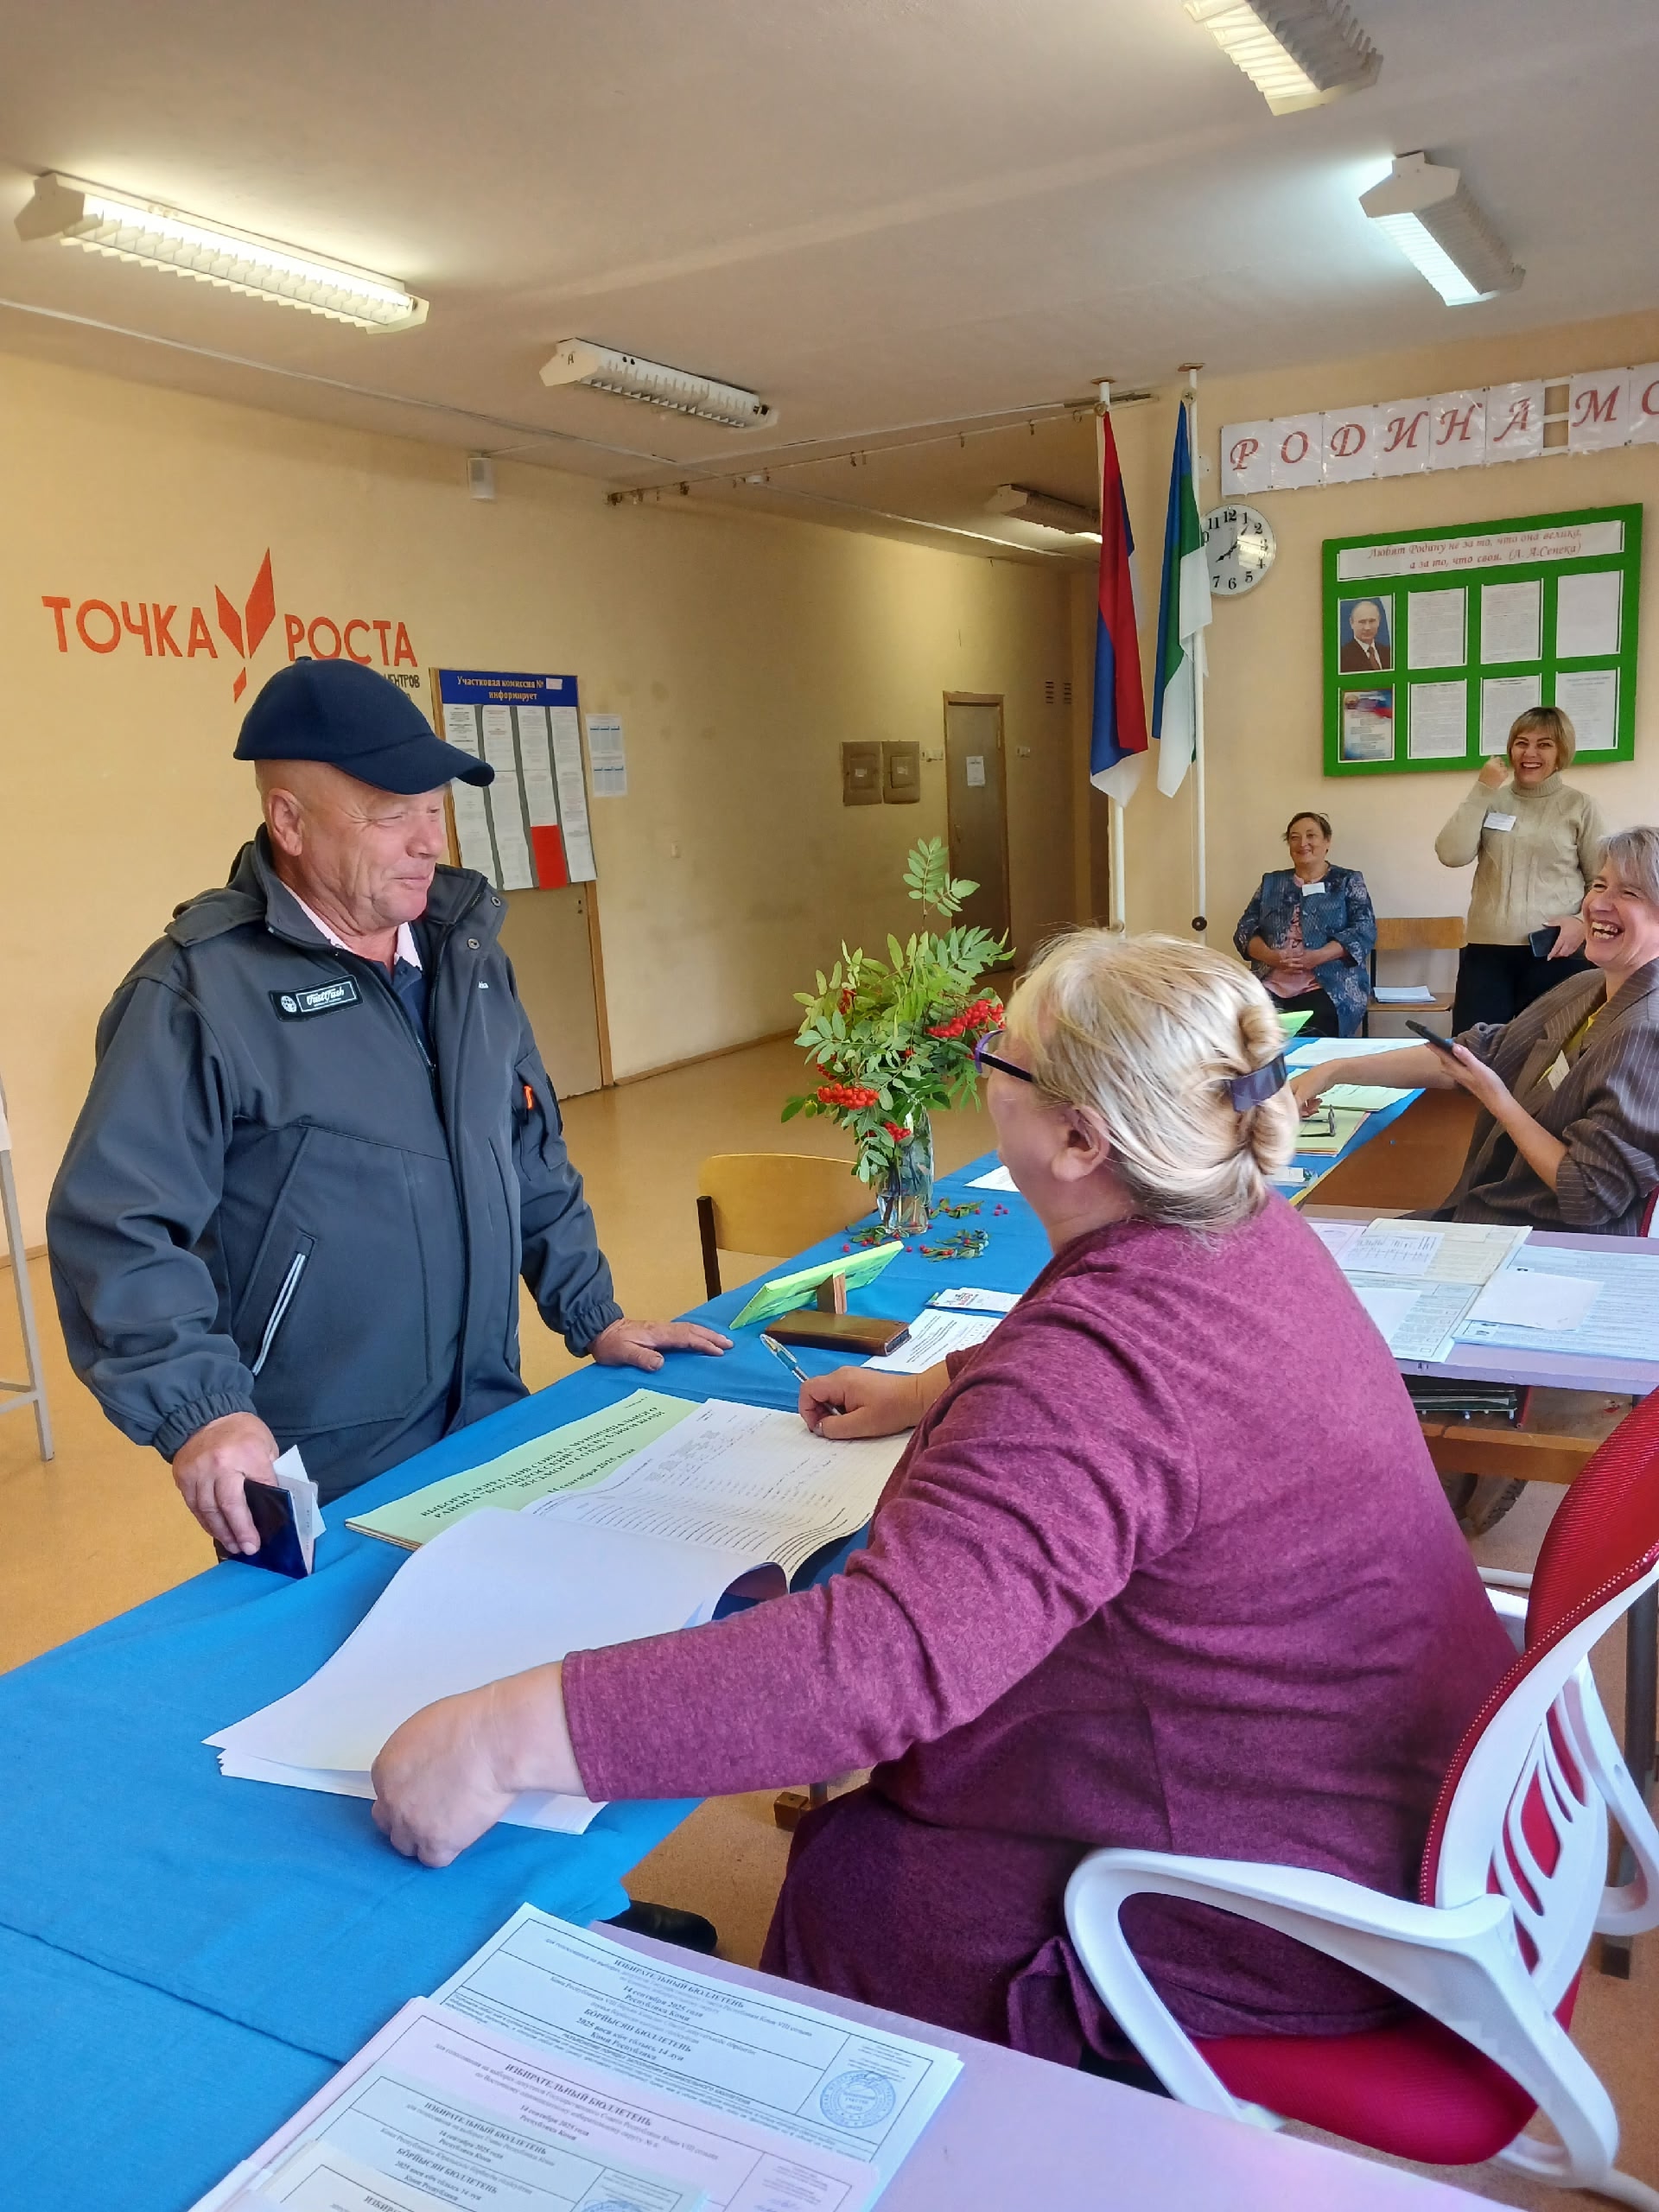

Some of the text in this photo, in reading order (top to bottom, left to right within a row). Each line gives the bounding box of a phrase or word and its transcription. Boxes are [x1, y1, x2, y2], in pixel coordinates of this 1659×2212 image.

[1230, 397, 1531, 471] РОДИНА
[1208, 517, 1220, 530] 11
[1224, 509, 1237, 523] 12
[1243, 512, 1248, 524] 1
[1255, 523, 1262, 535] 2
[1368, 544, 1406, 559] Любят
[1408, 542, 1446, 558] Родину
[1497, 537, 1517, 546] что
[1521, 532, 1539, 543] она
[1417, 559, 1429, 569] за
[1452, 556, 1473, 566] что
[1212, 575, 1220, 588] 7
[1228, 577, 1236, 589] 6
[1245, 571, 1253, 583] 5
[41, 595, 418, 667] ТОЧКА РОСТА
[384, 673, 421, 688] ЕНТРОВ
[457, 676, 501, 688] Участковая
[501, 679, 536, 689] комиссия
[488, 690, 537, 702] информирует
[597, 1458, 617, 1470] 2025
[420, 1493, 470, 1516] ВЫБОРЫ
[612, 1959, 689, 1990] ИЗБИРАТЕЛЬНЫЙ
[686, 1985, 746, 2010] БЮЛЛЕТЕНЬ
[622, 1993, 669, 2014] Республика
[668, 2010, 691, 2022] Коми
[631, 1989, 669, 2005] сентября
[667, 2001, 687, 2012] 2025
[684, 2008, 704, 2018] года
[574, 2017, 596, 2028] 2025
[657, 2047, 670, 2056] 14
[589, 2031, 613, 2044] Коми
[610, 2039, 658, 2062] Республика
[633, 2027, 693, 2053] БЮЛЛЕТЕНЬ
[503, 2063, 590, 2101] ИЗБИРАТЕЛЬНЫЙ
[588, 2096, 653, 2126] БЮЛЛЕТЕНЬ
[423, 2101, 495, 2134] ИЗБИРАТЕЛЬНЫЙ
[493, 2130, 548, 2155] БЮЛЛЕТЕНЬ
[442, 2168, 500, 2194] БЮЛЛЕТЕНЬ
